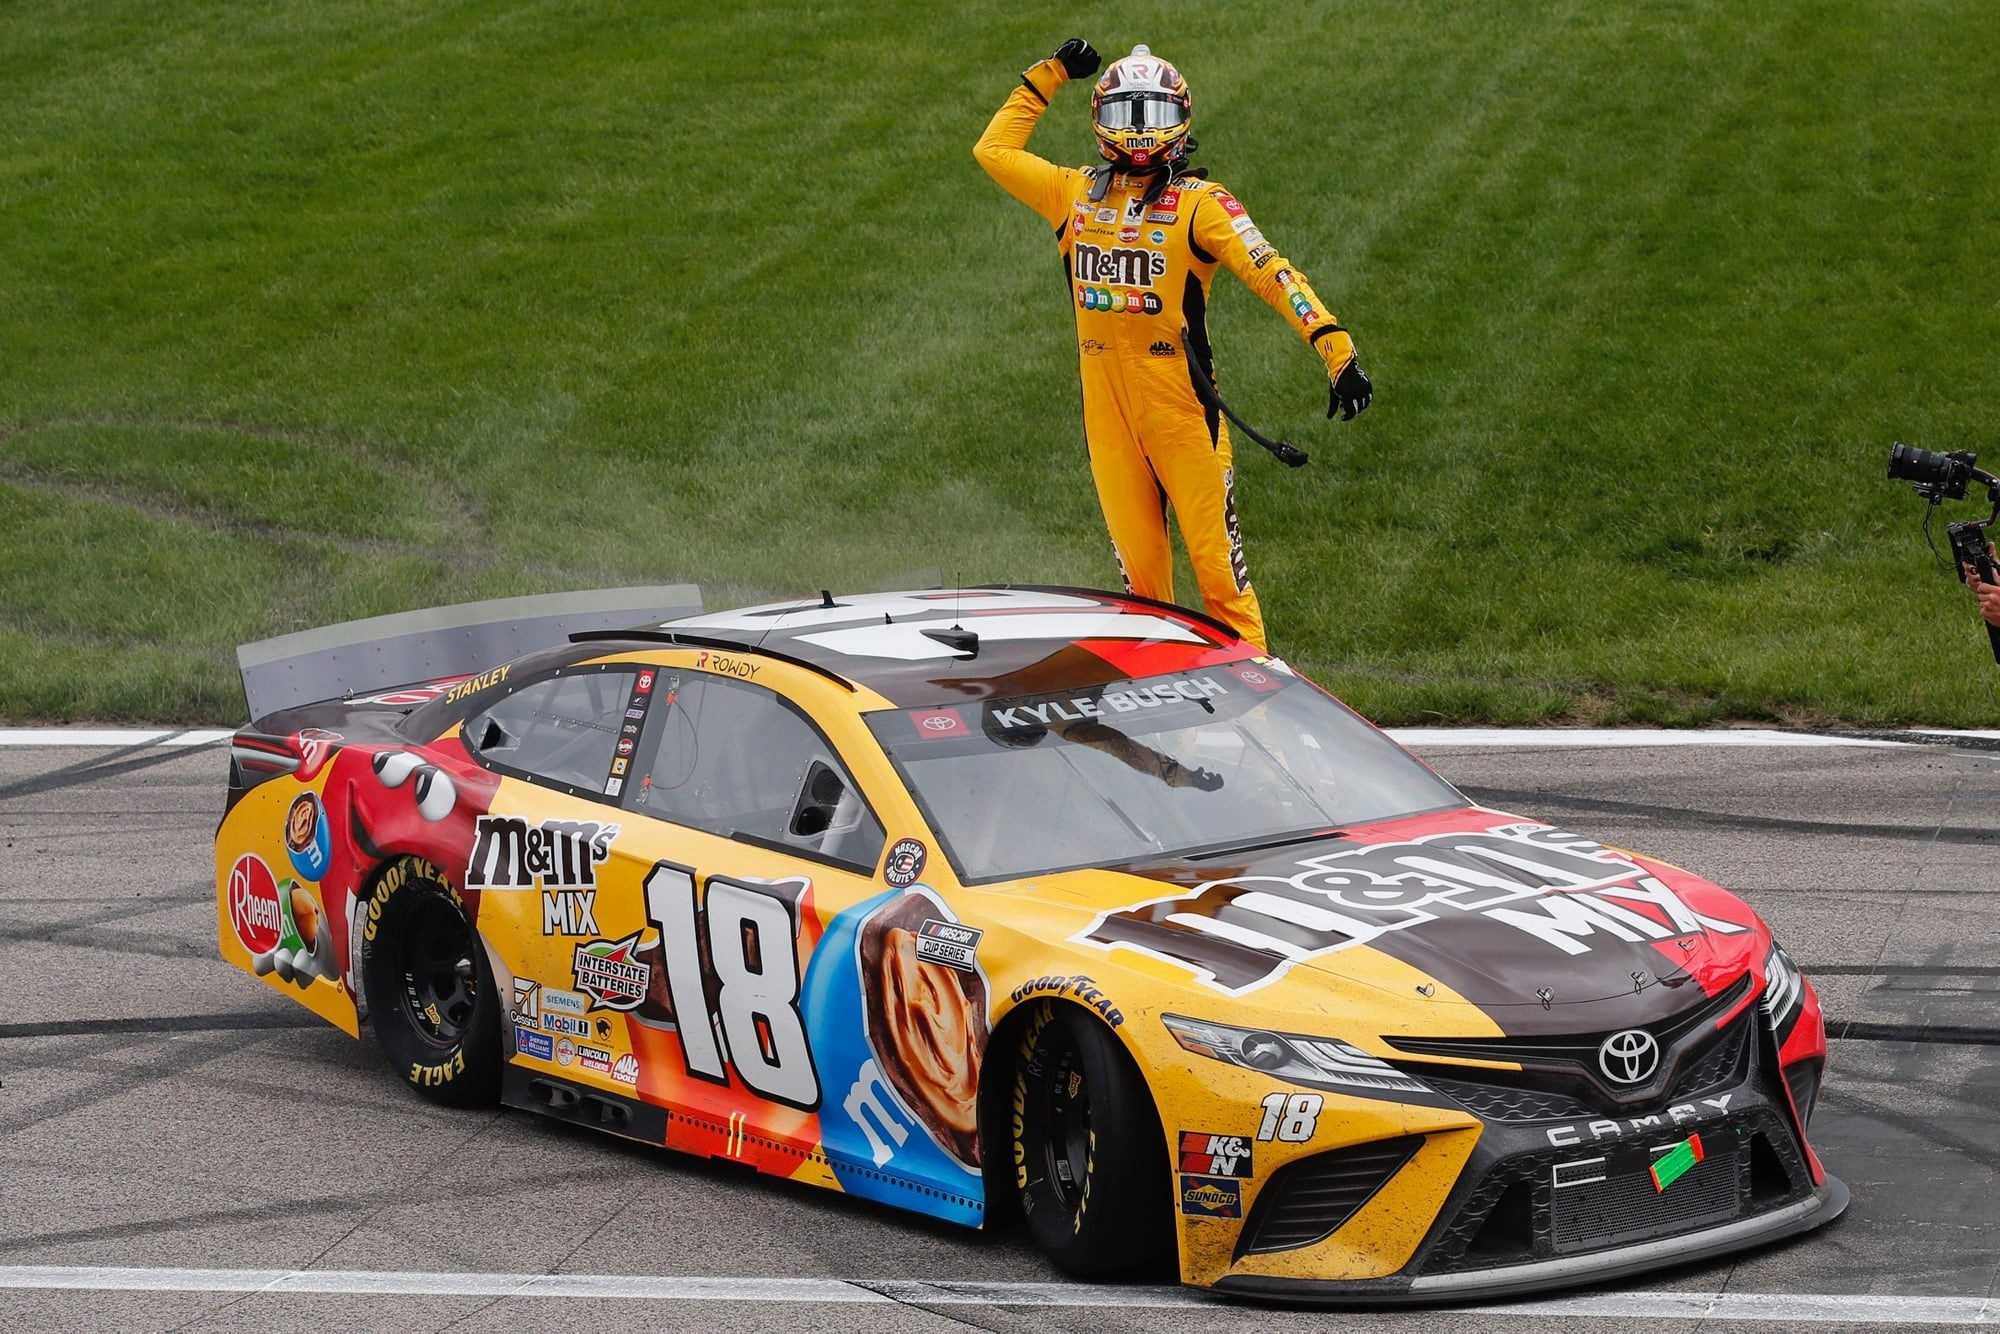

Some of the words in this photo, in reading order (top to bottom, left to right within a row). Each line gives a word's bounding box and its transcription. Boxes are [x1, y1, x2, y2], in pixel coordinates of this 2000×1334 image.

[1149, 213, 1175, 222] SNICKERS
[712, 654, 761, 679] ROWDY
[446, 664, 511, 704] STANLEY
[993, 698, 1105, 729] KYLE
[1103, 676, 1229, 714] BUSCH
[895, 843, 923, 860] NASCAR
[886, 865, 915, 883] SALUTES
[234, 856, 281, 938] Rheem
[365, 856, 463, 941] GOODYEAR
[542, 890, 601, 936] MIX
[1480, 877, 1748, 956] MIX
[939, 925, 973, 943] NASCAR
[923, 941, 939, 954] CUP
[939, 945, 966, 961] SERIES
[579, 954, 647, 983] INTERSTATE
[581, 972, 642, 998] BATTERIES
[643, 860, 822, 1113] 18
[546, 994, 580, 1009] SIEMENS
[1011, 975, 1125, 1029] GOODYEAR
[510, 1009, 539, 1030] Cessna
[543, 1013, 576, 1032] Mobil
[578, 1047, 609, 1062] LINCOLN
[583, 1059, 609, 1071] WELDERS
[615, 1055, 639, 1076] MAC
[409, 1048, 466, 1087] EAGLE
[612, 1071, 636, 1084] TOOLS
[1256, 1092, 1325, 1143] 18
[1546, 1094, 1733, 1147] CAMRY
[1206, 1135, 1251, 1158] K&
[1208, 1156, 1238, 1176] N
[1185, 1190, 1238, 1205] SUNOCO
